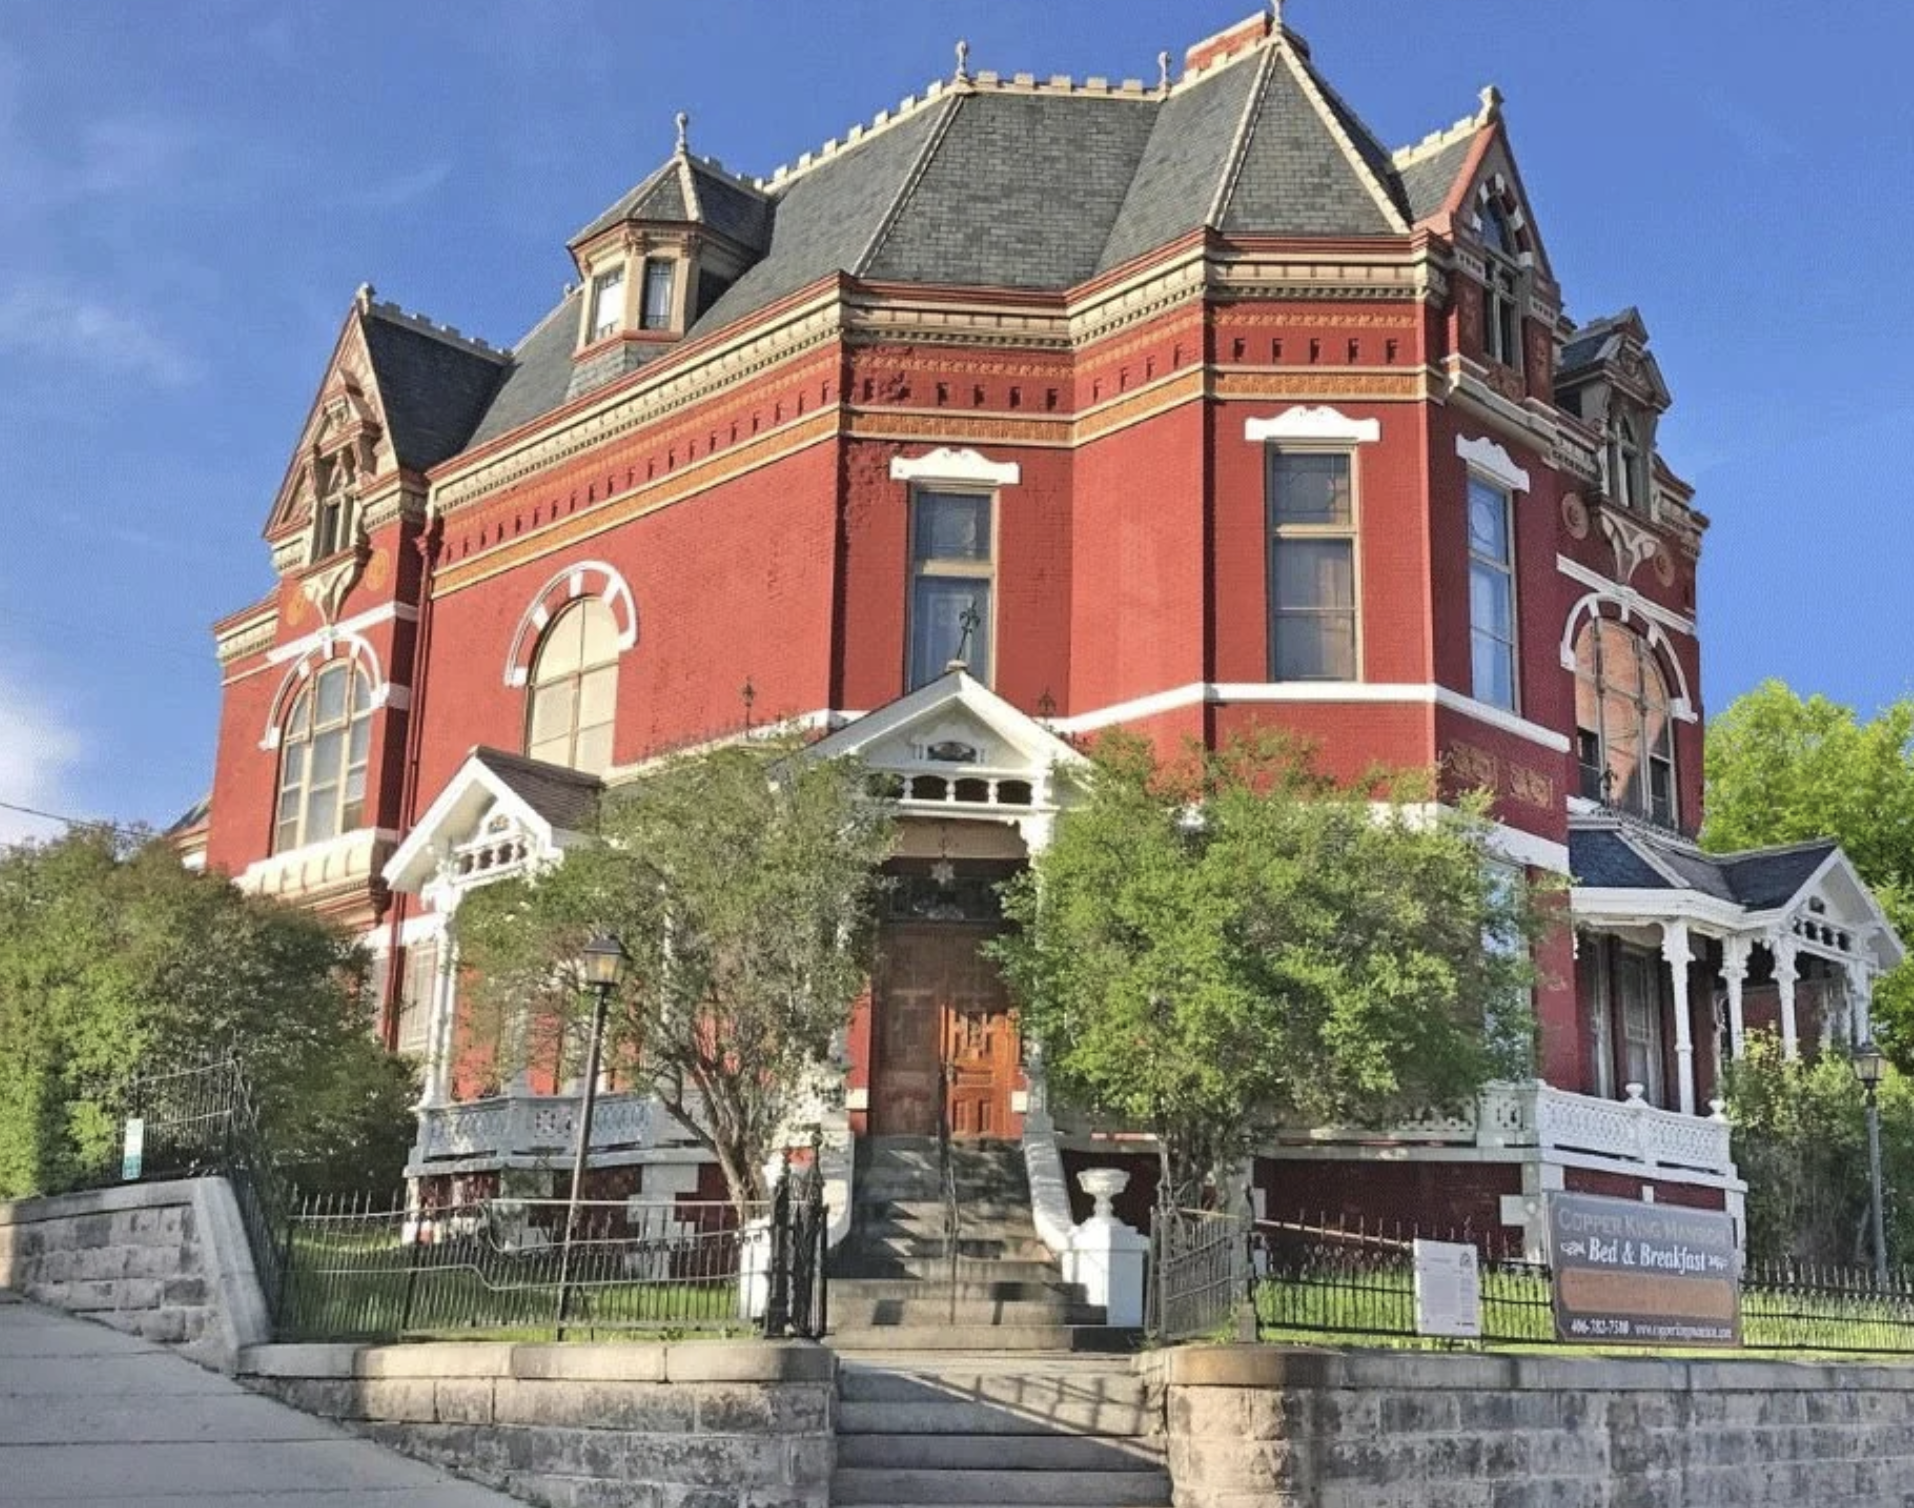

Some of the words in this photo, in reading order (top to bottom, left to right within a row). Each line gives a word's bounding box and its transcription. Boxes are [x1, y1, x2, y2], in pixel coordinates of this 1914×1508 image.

[1588, 1236, 1617, 1263] Bed
[1622, 1240, 1635, 1265] &
[1640, 1242, 1706, 1275] Breakfast
